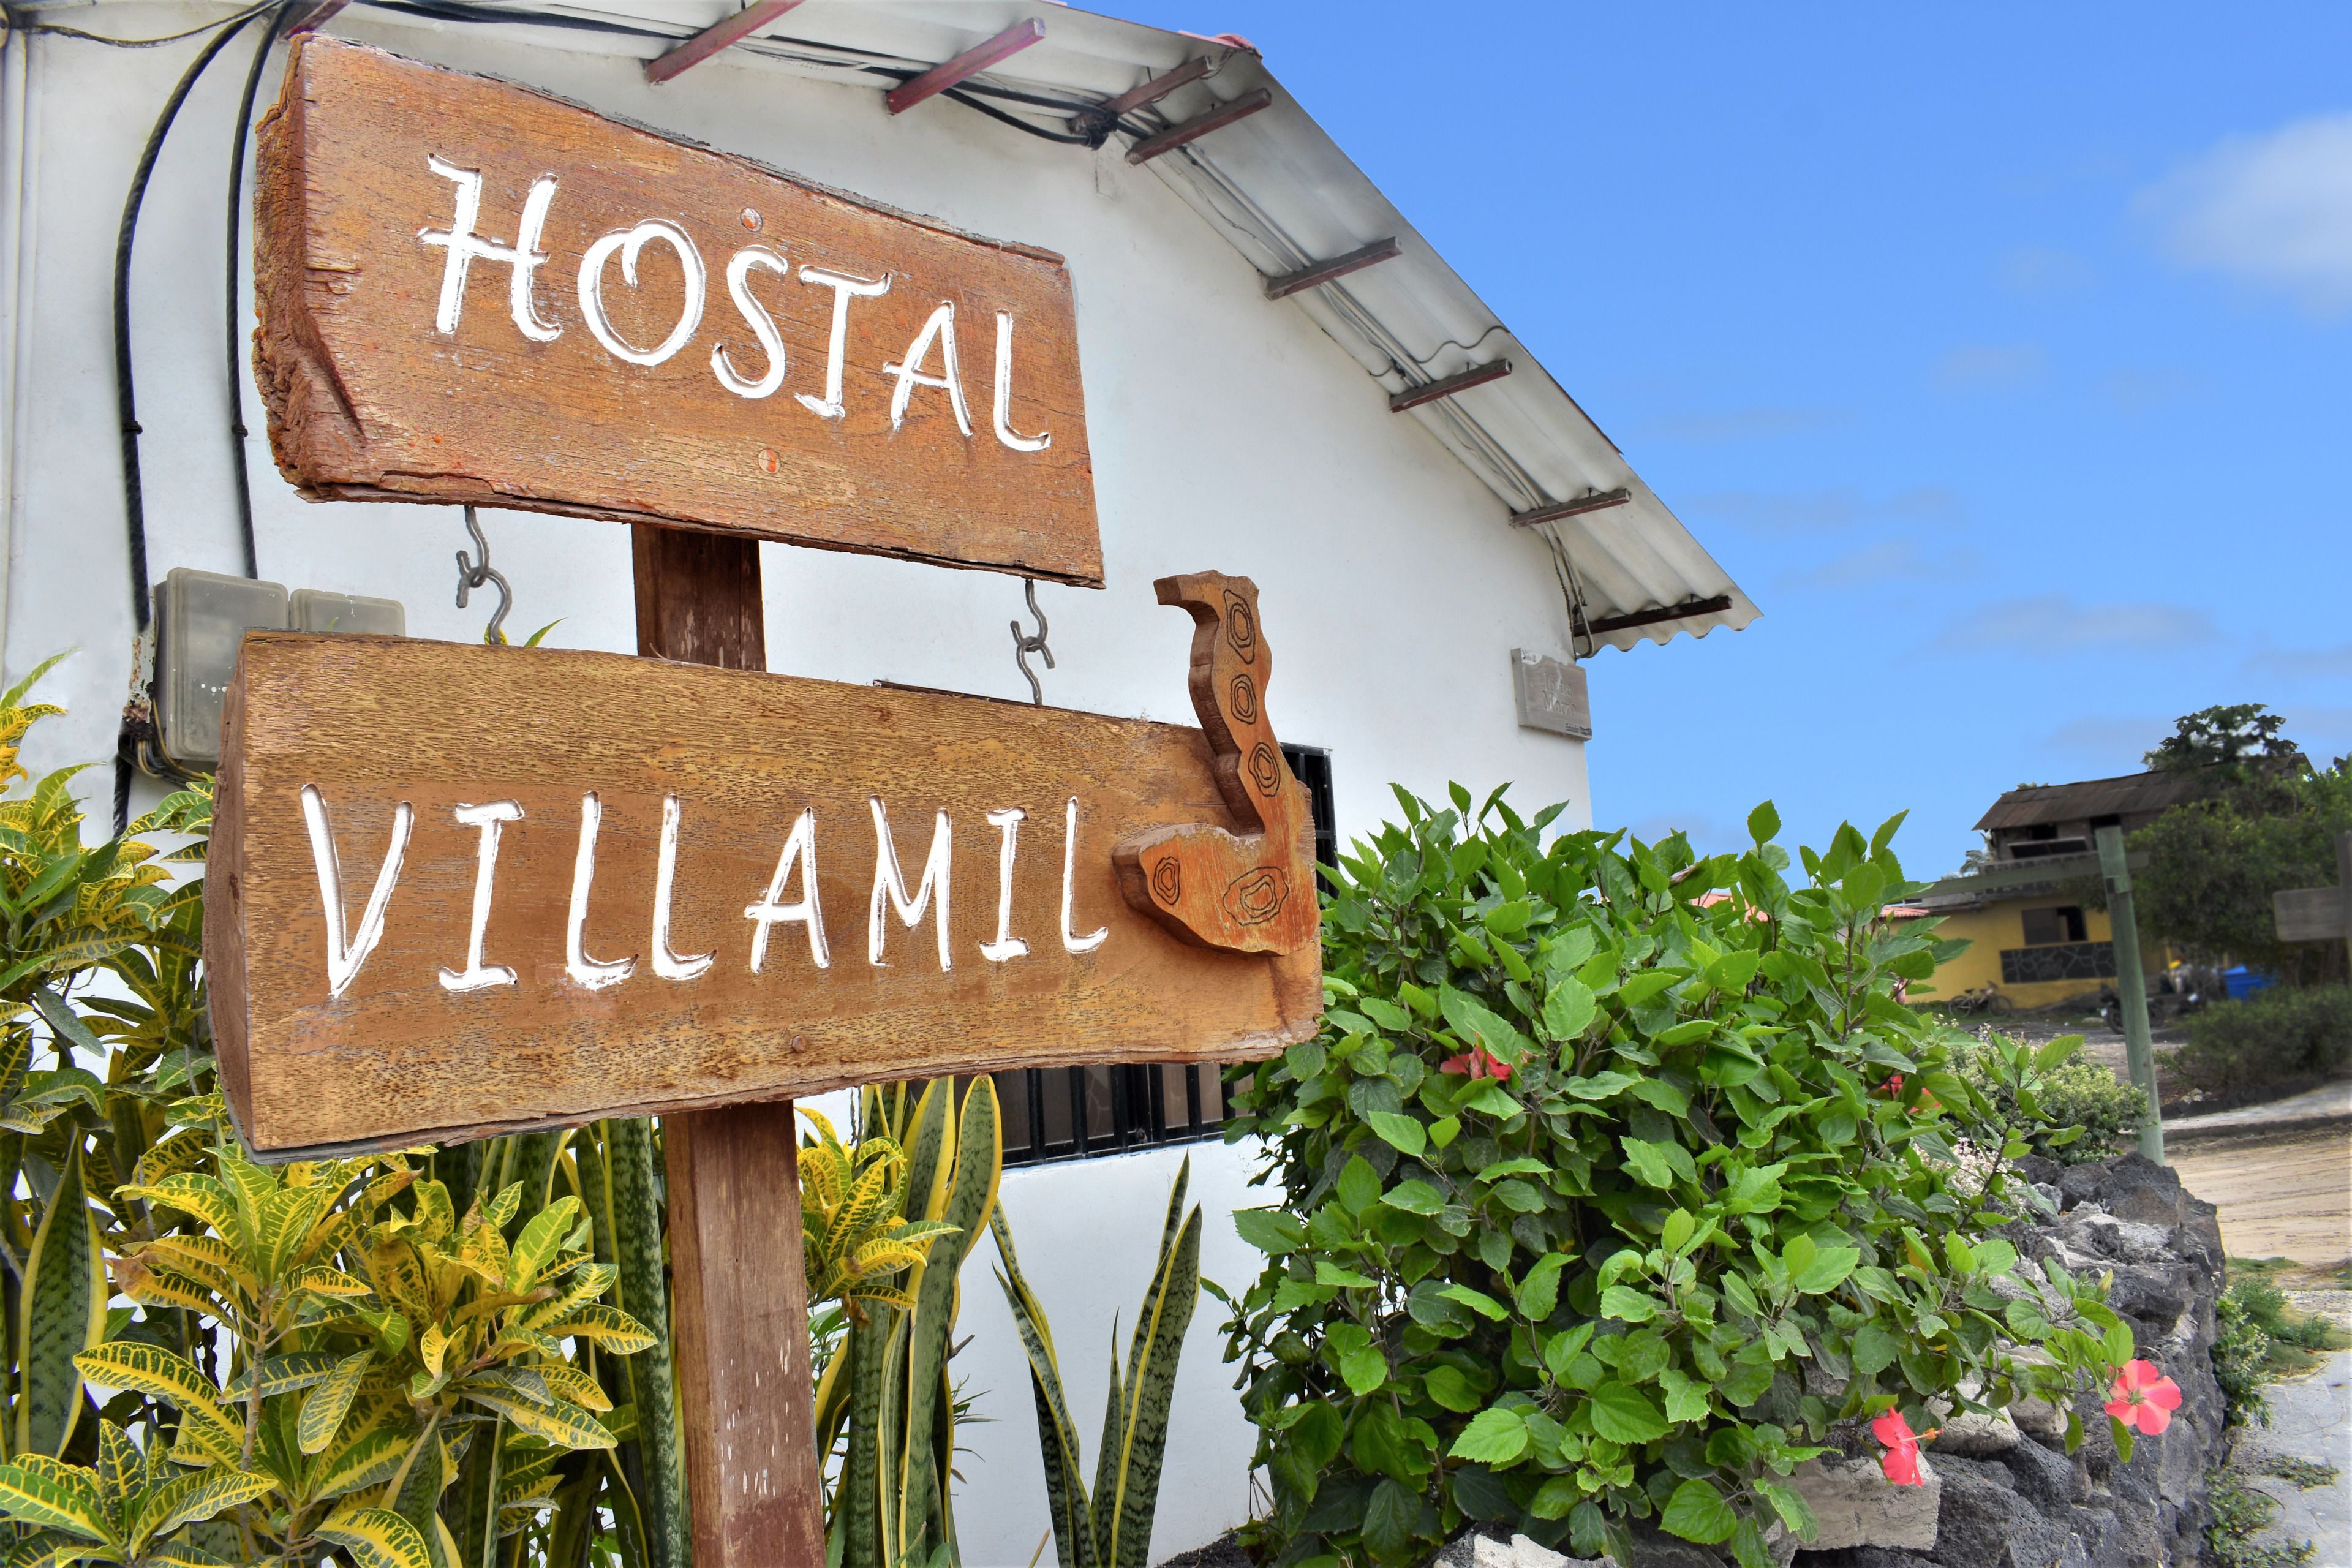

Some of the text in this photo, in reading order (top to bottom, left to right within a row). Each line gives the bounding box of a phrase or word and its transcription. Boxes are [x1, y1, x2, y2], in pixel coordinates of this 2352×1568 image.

[418, 152, 1052, 453] HOSTAL
[1543, 672, 1555, 692] 16
[301, 784, 1110, 1000] VILLAMIL
